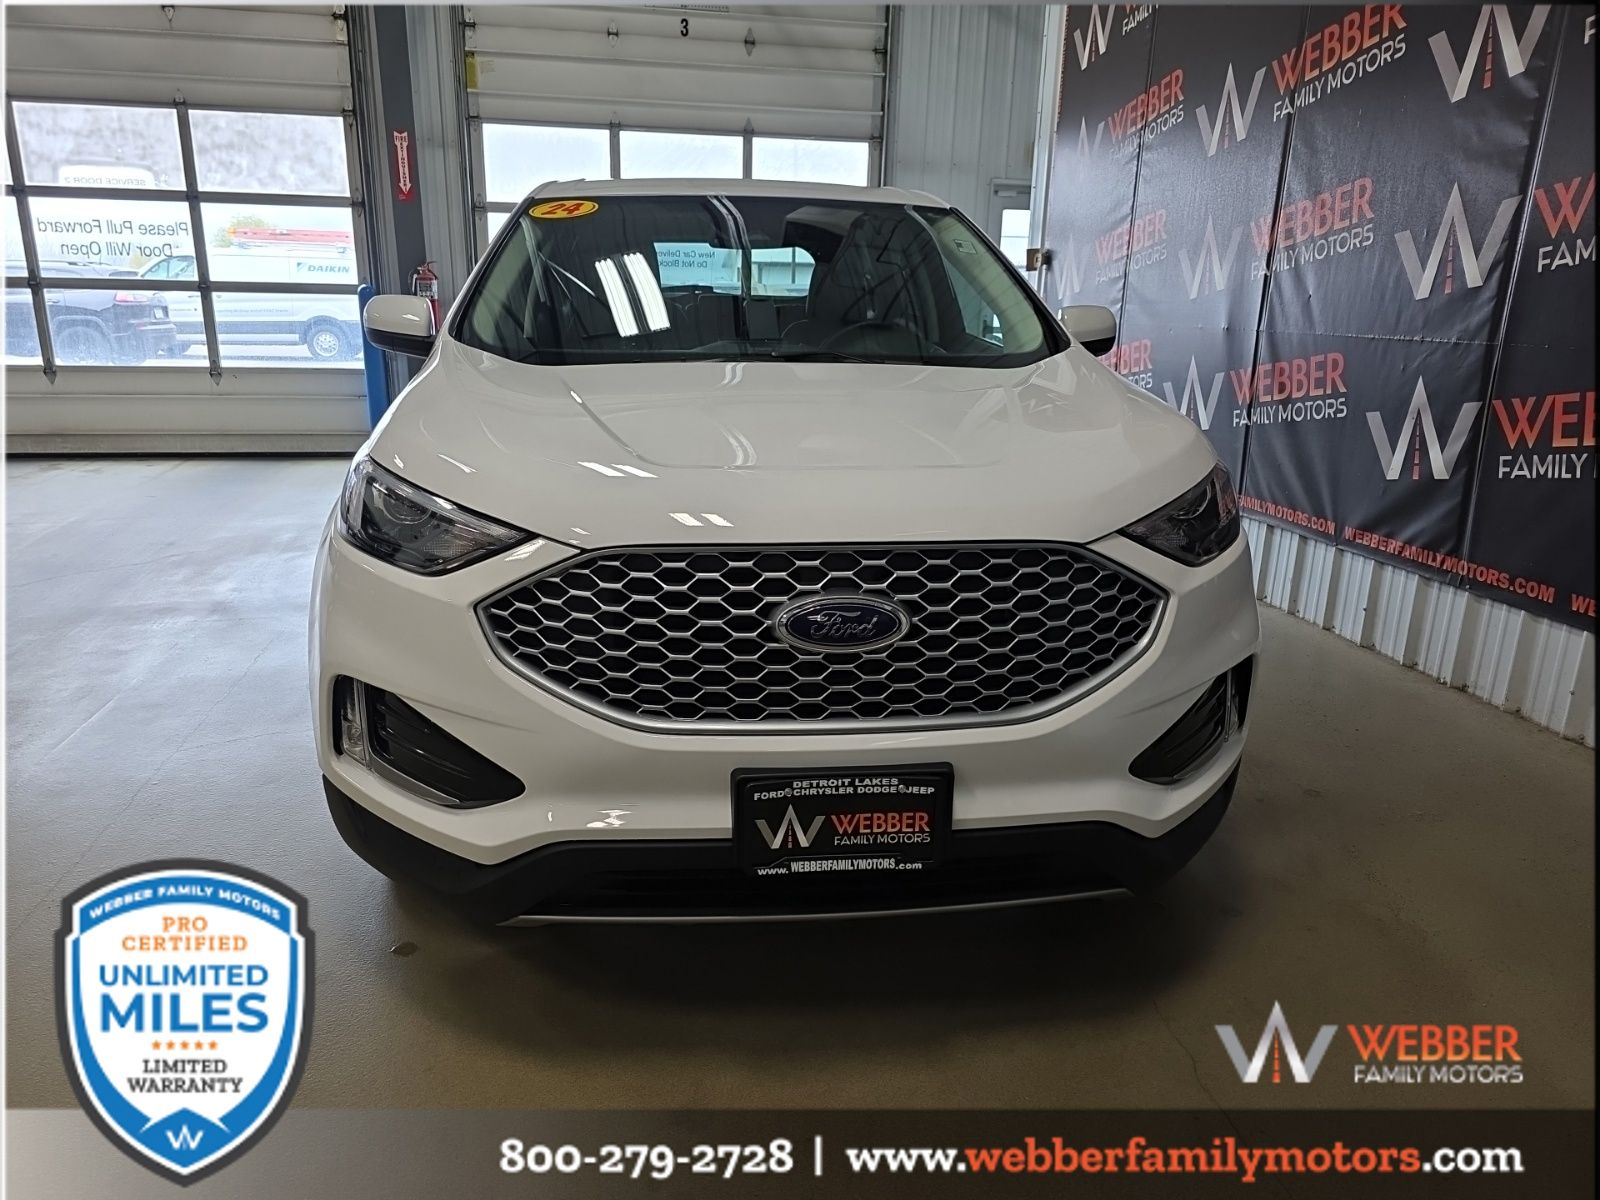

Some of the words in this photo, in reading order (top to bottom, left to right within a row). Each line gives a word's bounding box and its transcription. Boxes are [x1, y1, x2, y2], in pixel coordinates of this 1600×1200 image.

[681, 18, 689, 37] 3
[1272, 4, 1408, 95] WEBBER
[1273, 77, 1326, 122] FAMILY
[1327, 34, 1406, 94] MOTORS
[1108, 69, 1184, 144] WEBBER
[541, 203, 585, 215] 24
[1251, 177, 1375, 256] WEBBER
[1302, 224, 1374, 265] MOTORS
[307, 264, 350, 273] DAIKIN
[1230, 352, 1347, 406] WEBBER
[1233, 406, 1275, 427] FAMILY
[1278, 398, 1347, 423] MOTORS
[1498, 453, 1588, 479] FAMILY
[1344, 526, 1556, 603] WEBBERFAMILYMOTORS.COM
[807, 610, 879, 638] Ford
[754, 790, 785, 801] FORD
[793, 787, 854, 796] CHRYSLER
[857, 786, 897, 794] DODGE
[905, 786, 935, 795] JEEP
[793, 778, 851, 788] DETROIT
[855, 778, 898, 786] LAKES
[831, 812, 931, 835] WEBBER
[834, 834, 876, 846] FAMILY
[877, 833, 931, 844] MOTORS
